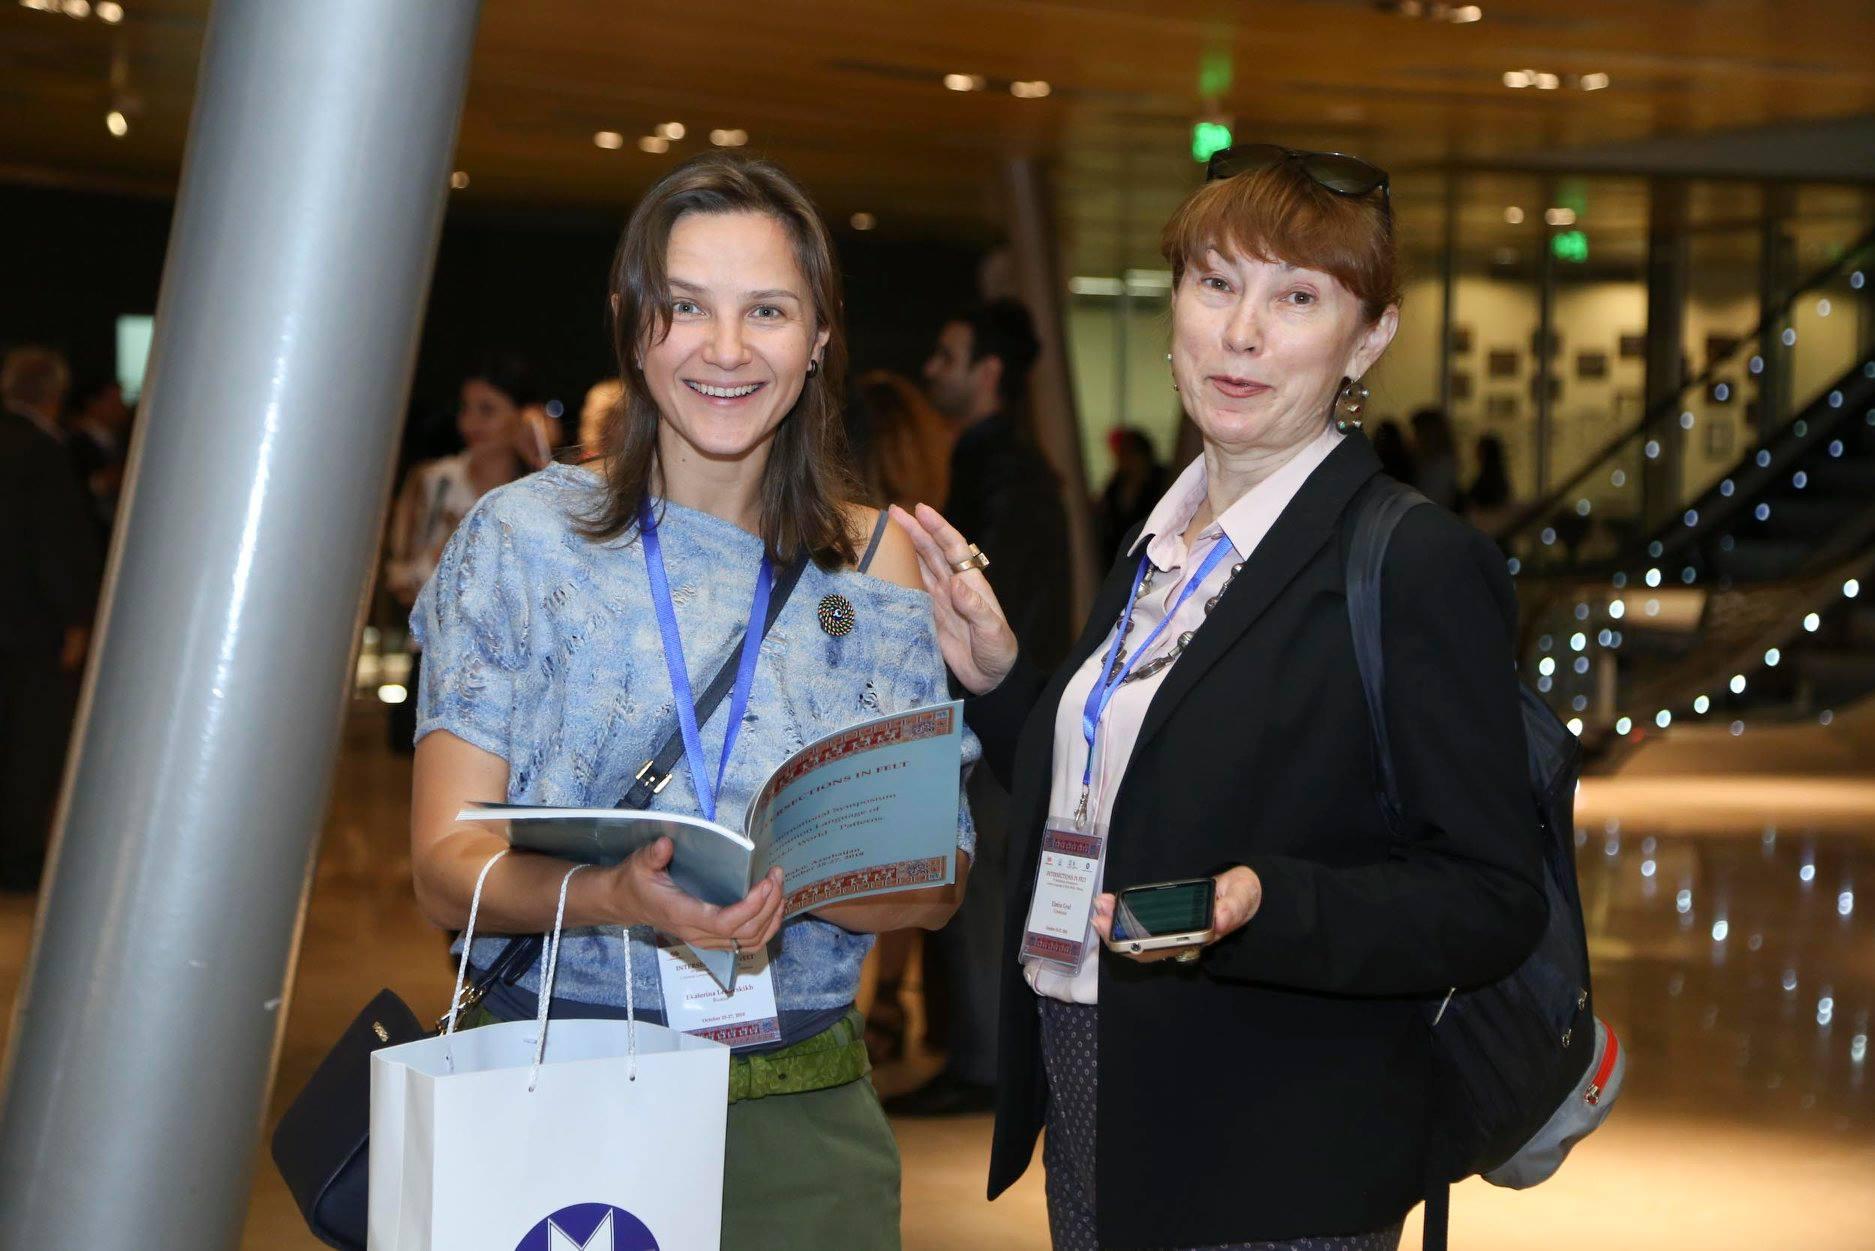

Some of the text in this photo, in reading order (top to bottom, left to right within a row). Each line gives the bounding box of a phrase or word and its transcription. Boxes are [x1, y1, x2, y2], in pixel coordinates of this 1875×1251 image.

[856, 769, 872, 778] IN
[876, 760, 910, 774] FELT
[686, 991, 716, 1001] Ekaterina
